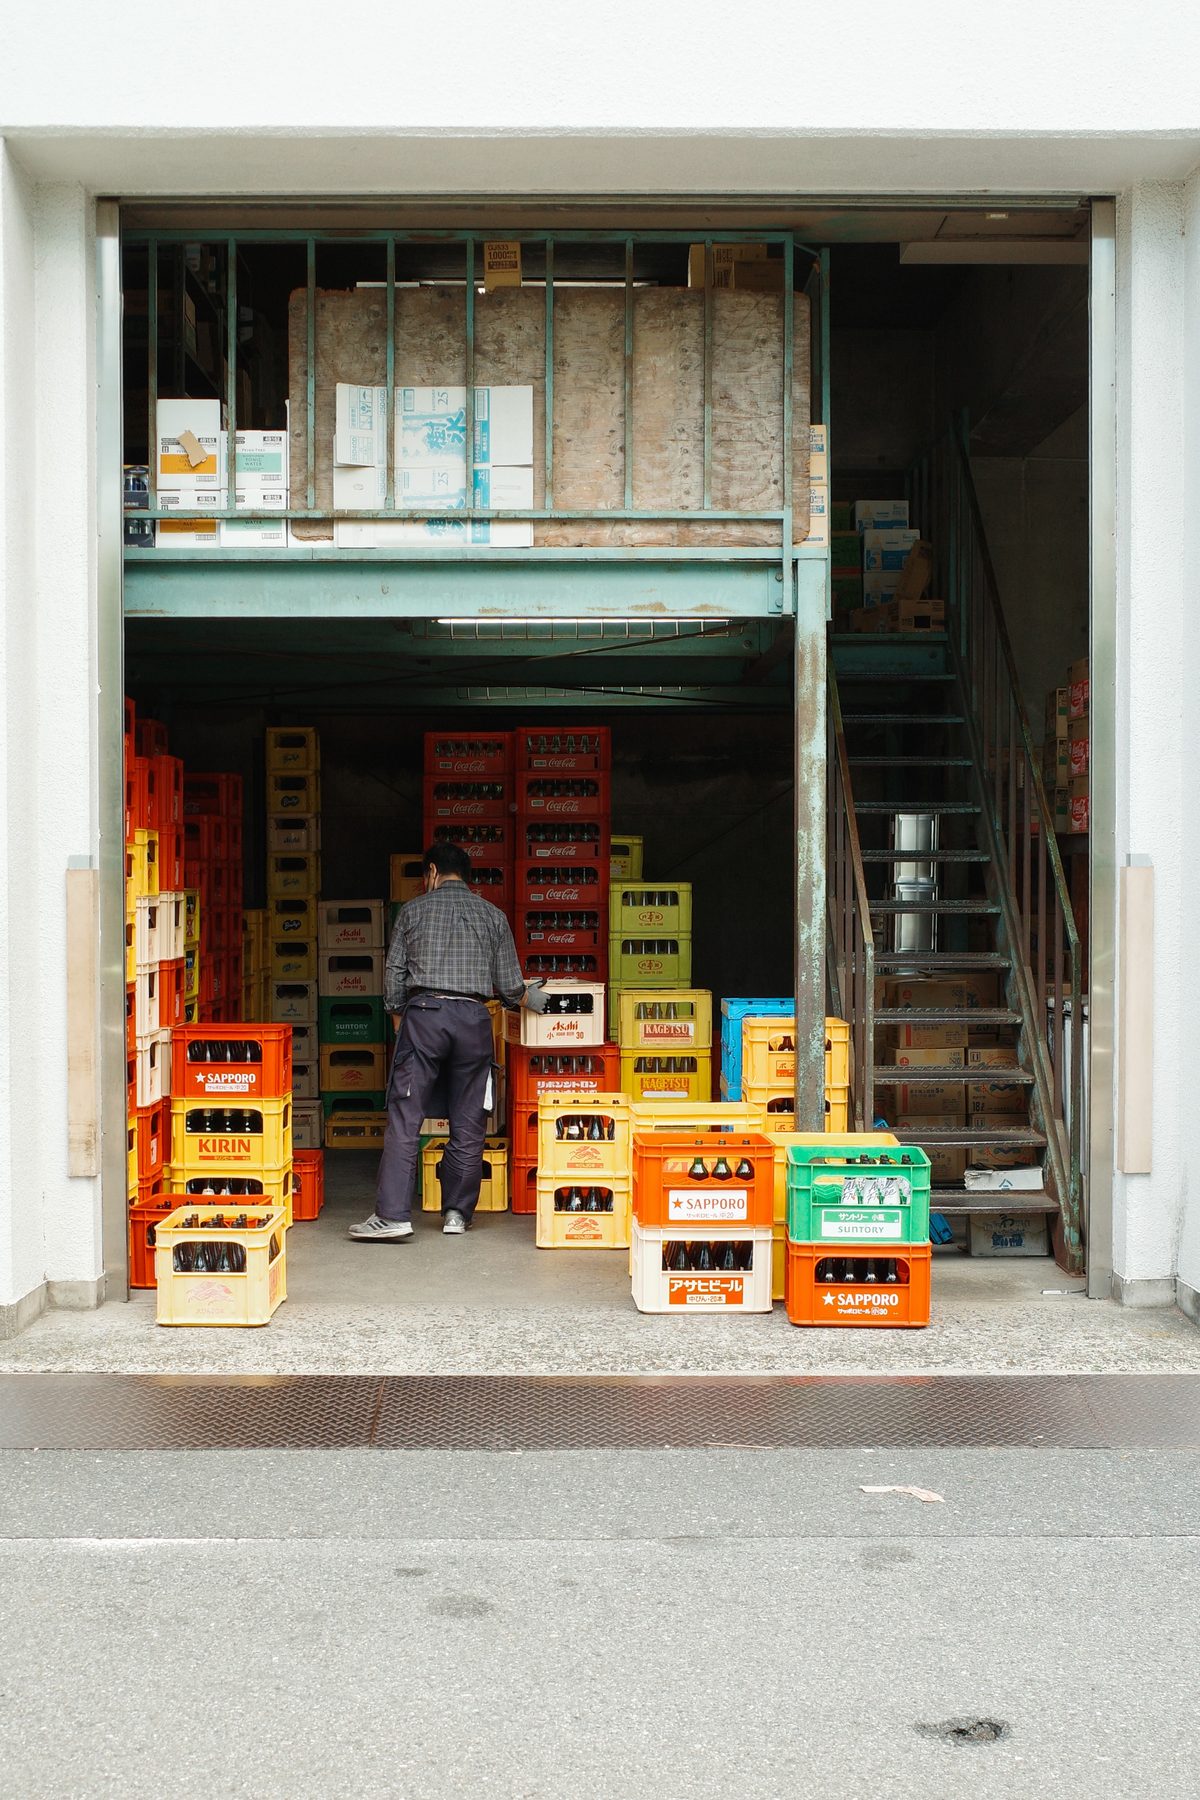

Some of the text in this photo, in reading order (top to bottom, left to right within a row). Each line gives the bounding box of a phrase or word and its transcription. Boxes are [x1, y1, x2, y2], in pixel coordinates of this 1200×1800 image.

[552, 1020, 578, 1031] Asahi
[646, 1024, 688, 1034] KAGETSU
[207, 1073, 256, 1083] SAPPORO
[643, 1078, 688, 1088] KAGETSU
[199, 1139, 250, 1152] KIRIN
[687, 1198, 745, 1210] SAPPORO
[670, 1280, 742, 1292] アサヒビール
[837, 1294, 899, 1306] SAPPORO
